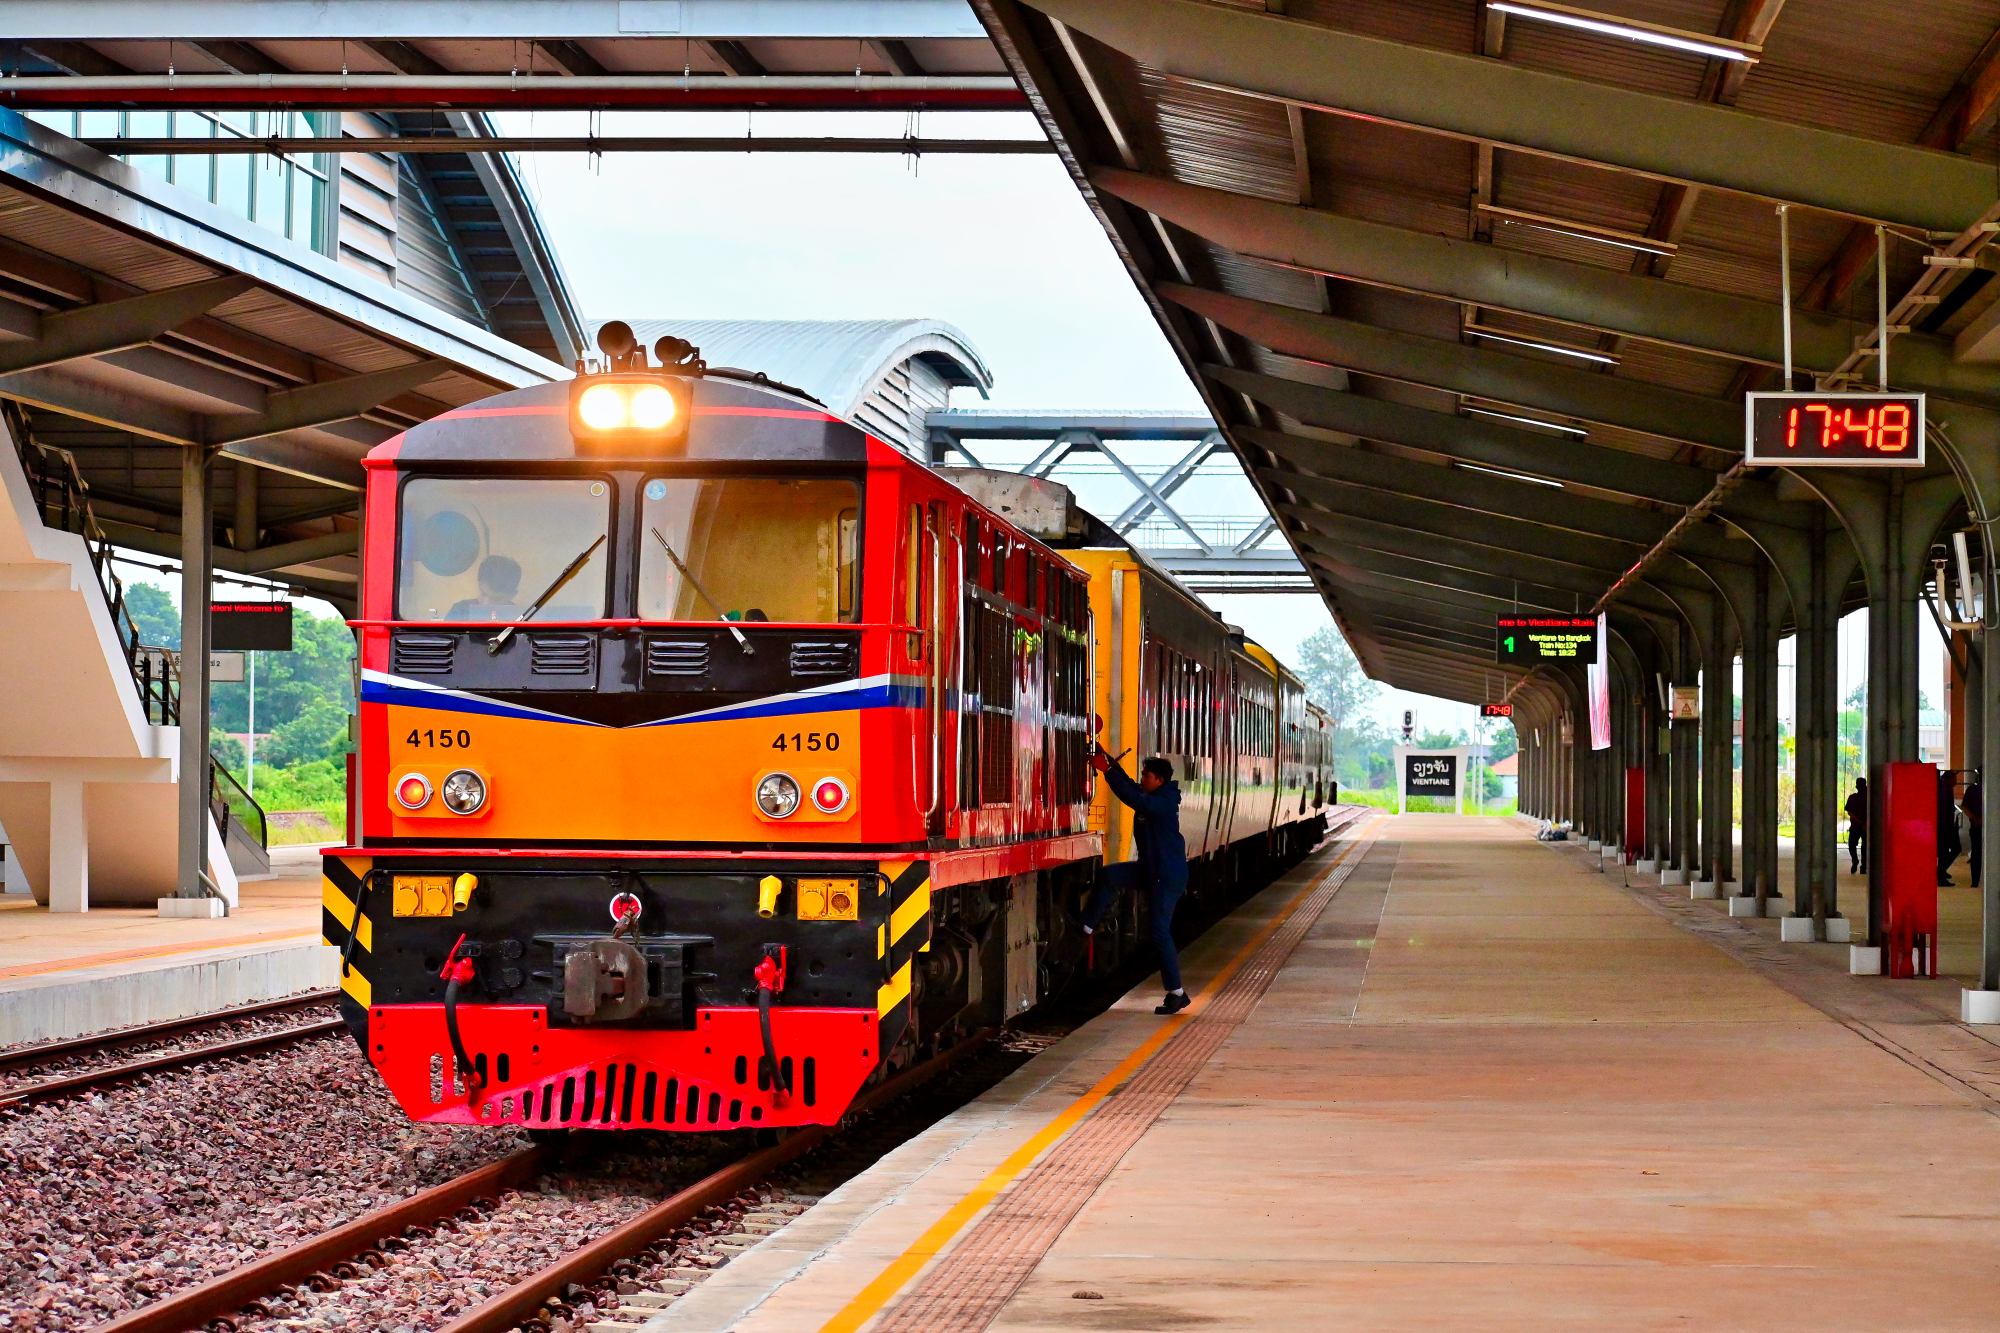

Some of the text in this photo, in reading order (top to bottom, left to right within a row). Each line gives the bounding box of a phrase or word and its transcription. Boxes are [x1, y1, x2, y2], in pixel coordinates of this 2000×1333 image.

[1788, 405, 1910, 452] 17:48
[1517, 619, 1527, 627] to
[1528, 619, 1570, 627] Vientiane
[1504, 636, 1514, 652] 1
[1566, 634, 1591, 642] Bangkok
[1486, 705, 1510, 715] 17:48
[406, 729, 471, 748] 4150
[772, 732, 840, 752] 4150
